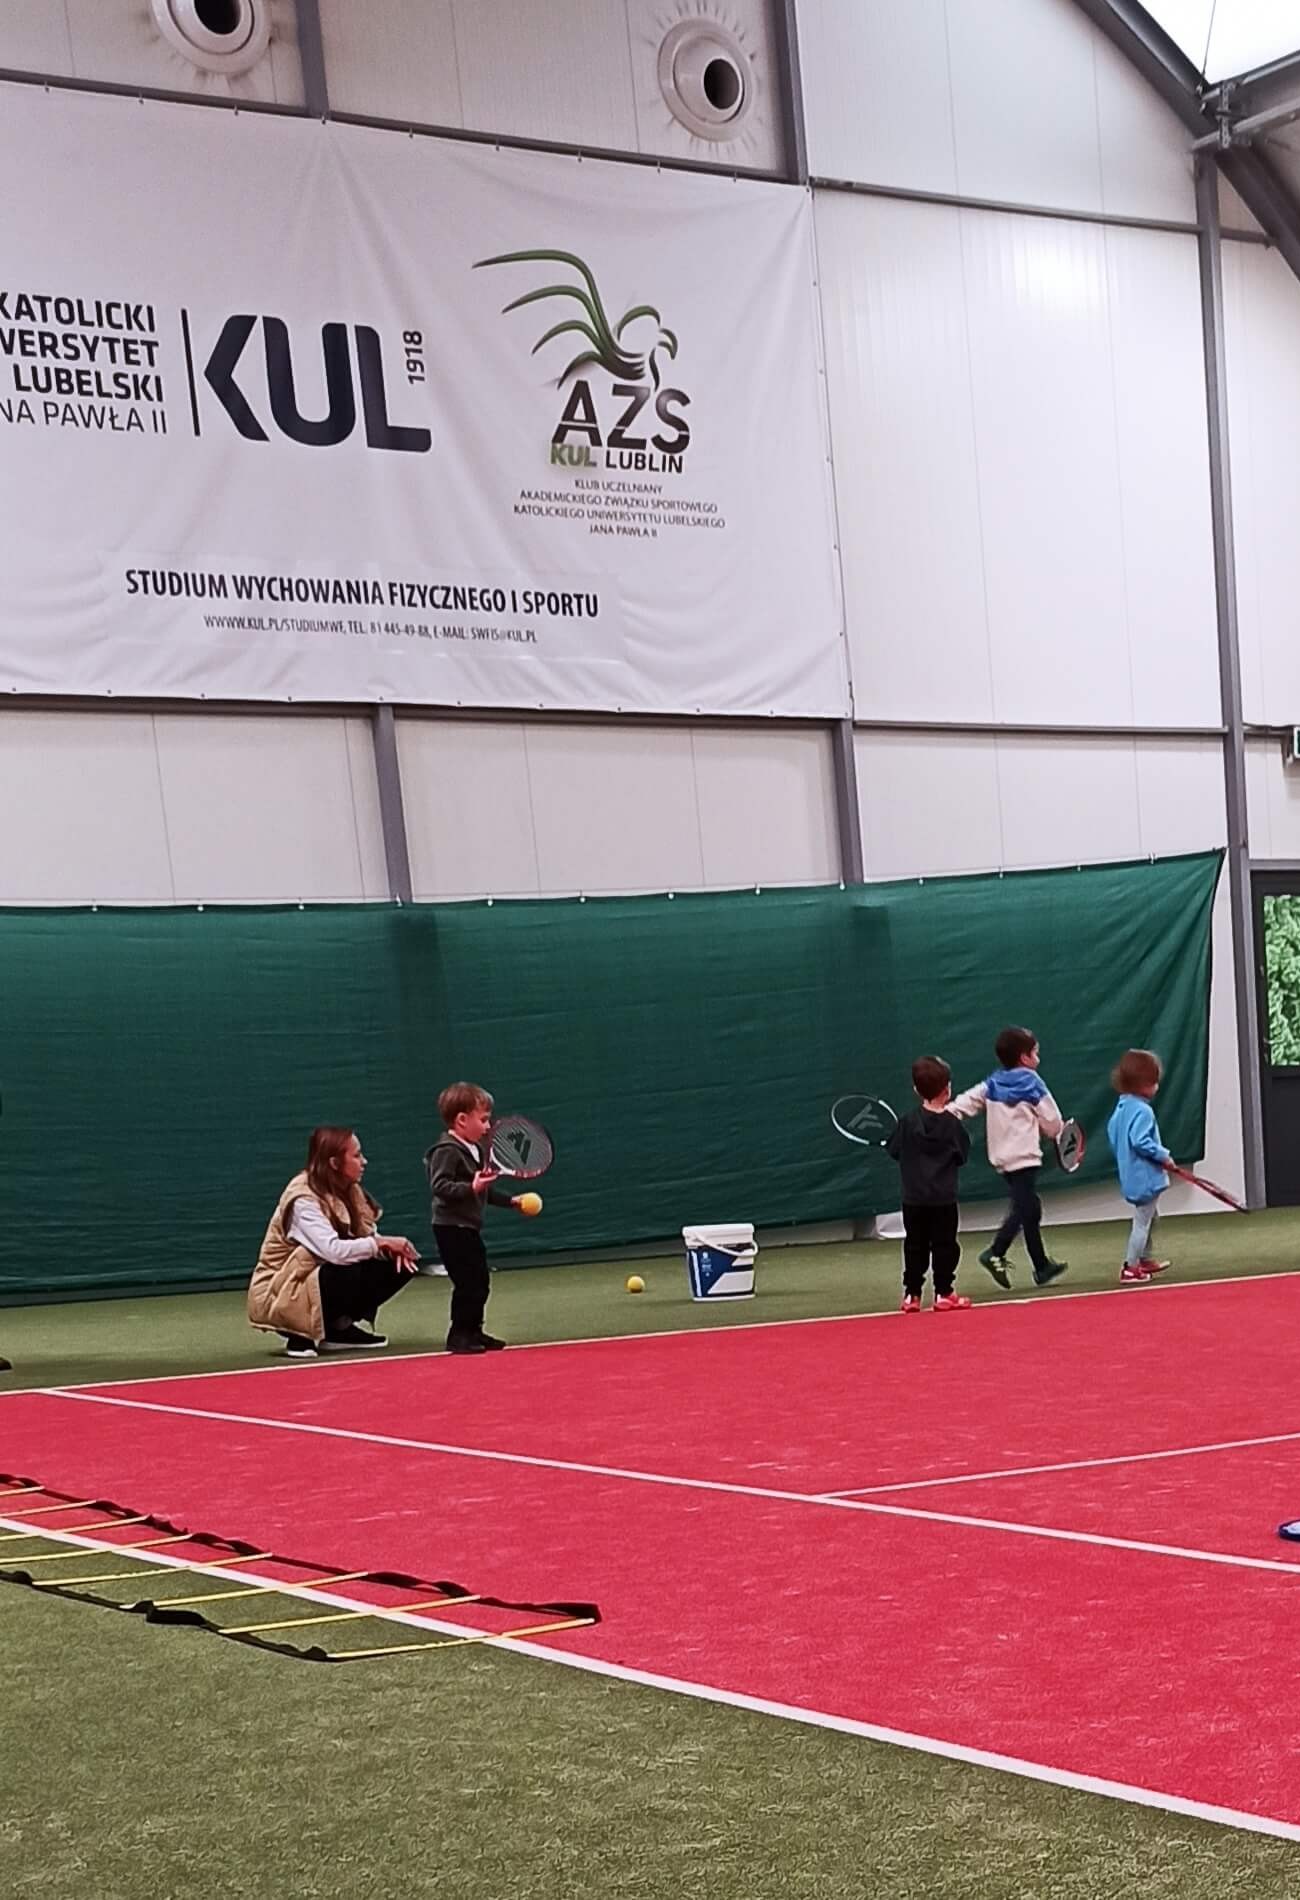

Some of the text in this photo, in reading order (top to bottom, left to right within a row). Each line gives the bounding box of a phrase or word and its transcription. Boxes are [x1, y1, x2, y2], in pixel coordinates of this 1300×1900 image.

[402, 330, 425, 385] 1918
[13, 363, 163, 402] LUBELSKI
[204, 314, 432, 453] KUL
[43, 401, 145, 433] PAWŁA
[152, 409, 167, 434] II
[551, 379, 691, 454] AZS
[551, 443, 683, 474] KUL LUBLIN
[520, 489, 602, 506] AKADEMICKIEGO
[651, 498, 718, 514] SPORTOWEGO
[574, 479, 663, 495] KLUB UCZELNIANY
[514, 504, 726, 529] KATOLICKIEGO UNIWERSYTETU LUBELSKIEGO
[589, 524, 614, 536] JANA
[126, 569, 599, 618] STUDIUM WYCHOWANIA FIZYCZNEGO I SPORTU
